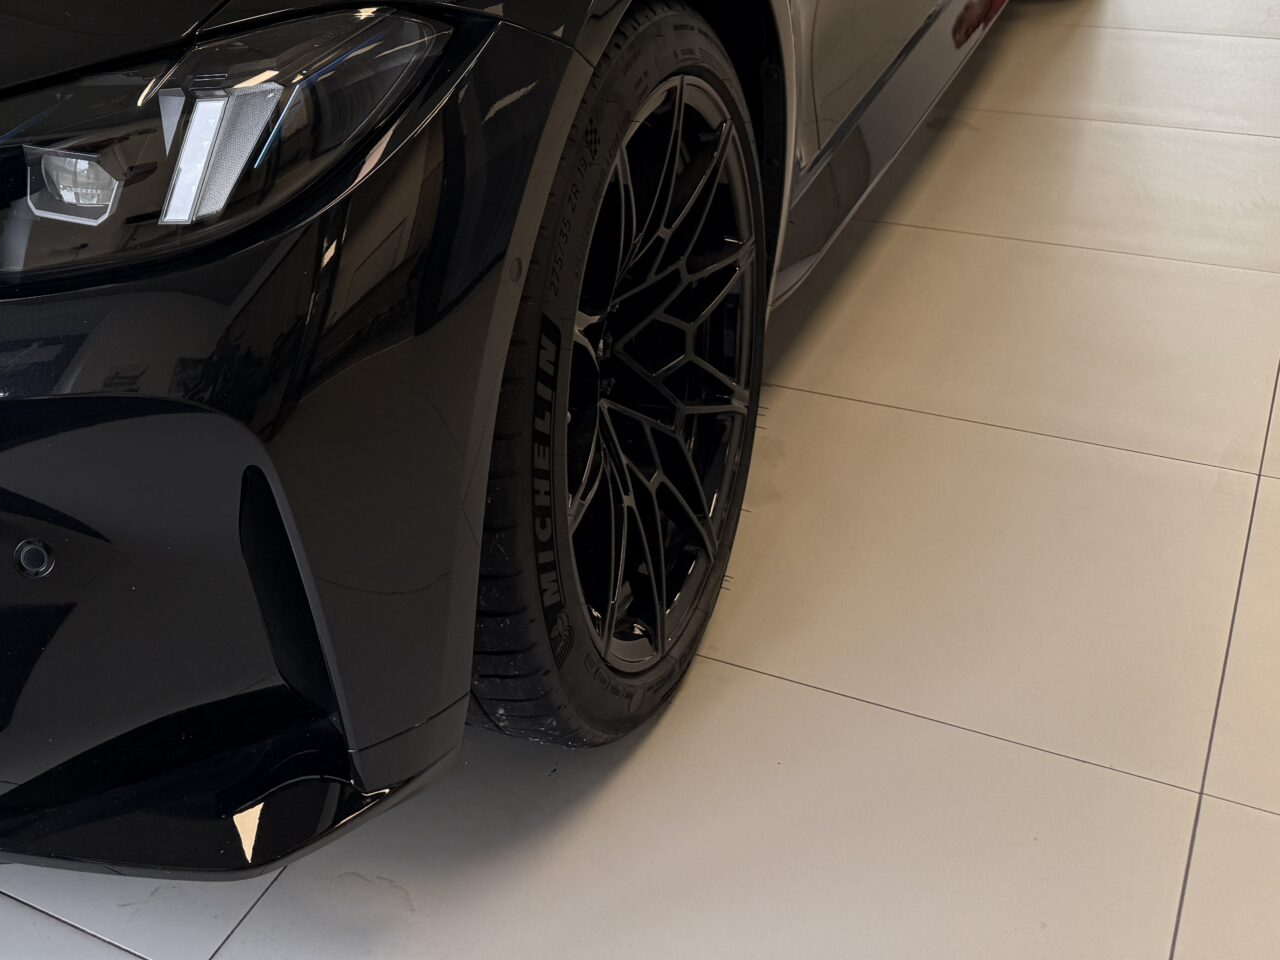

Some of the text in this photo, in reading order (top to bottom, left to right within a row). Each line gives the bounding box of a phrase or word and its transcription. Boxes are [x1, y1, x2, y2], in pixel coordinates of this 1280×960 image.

[549, 156, 589, 298] 275/35 ZR 19
[533, 335, 562, 608] MICHELIN
